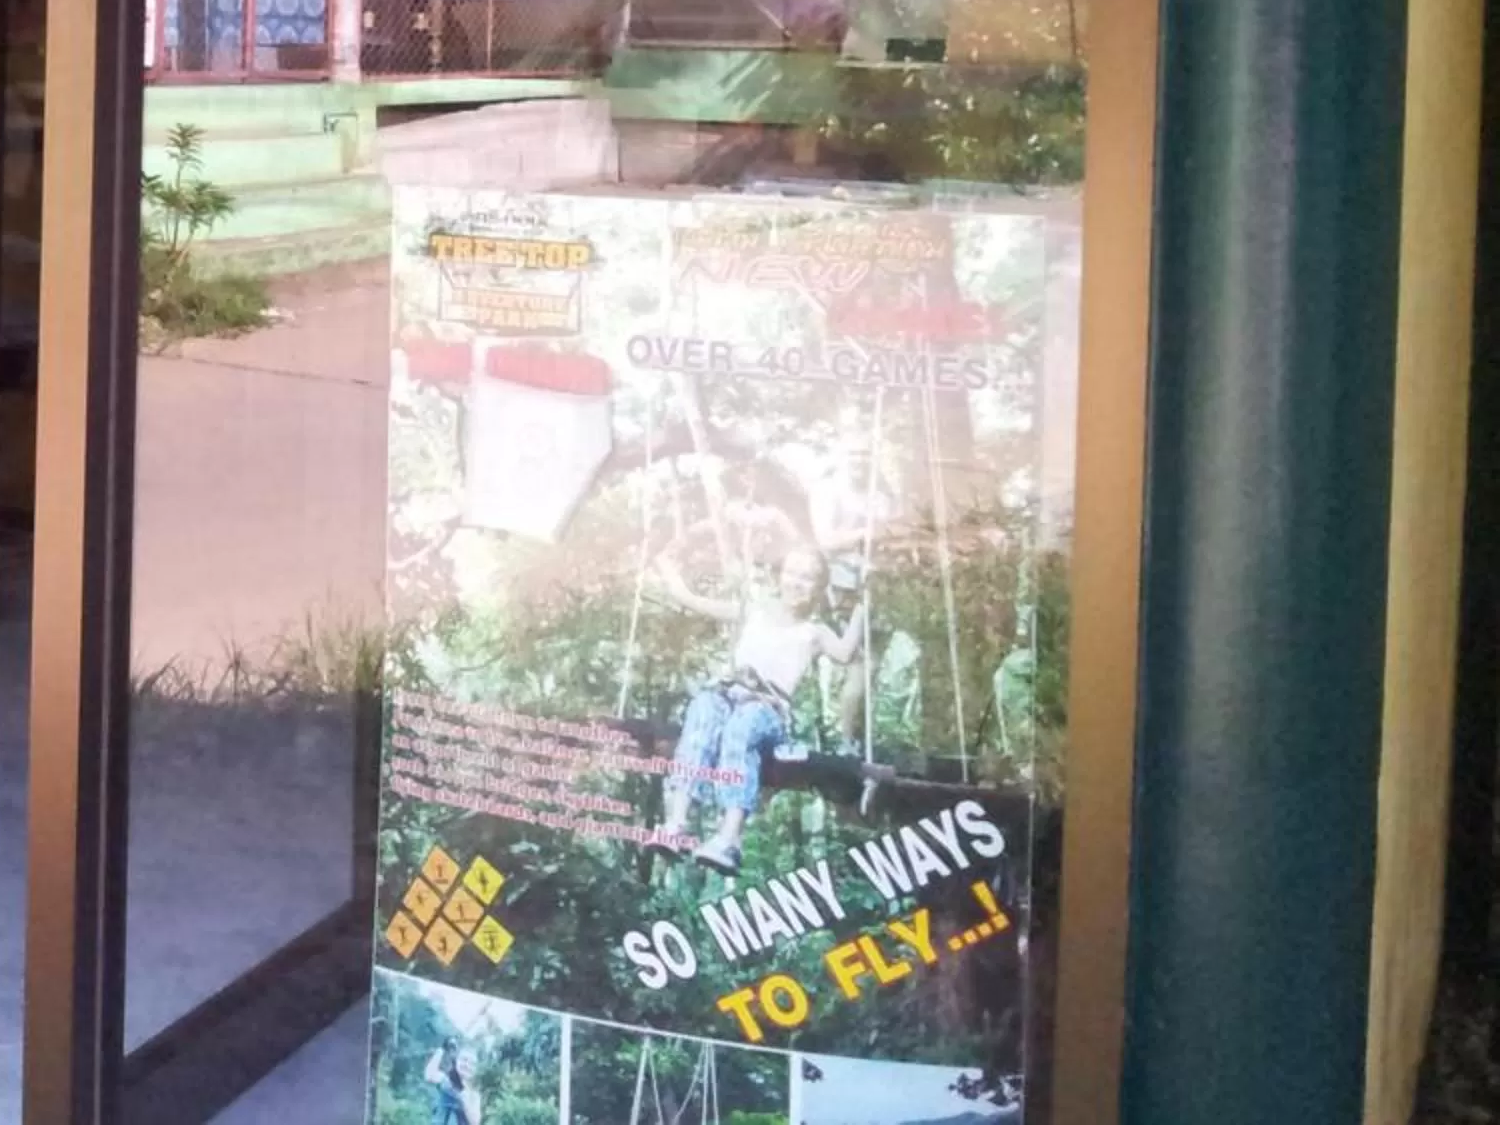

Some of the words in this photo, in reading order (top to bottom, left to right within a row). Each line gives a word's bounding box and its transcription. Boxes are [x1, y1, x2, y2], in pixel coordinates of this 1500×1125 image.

[626, 334, 735, 374] OVER
[756, 345, 806, 377] 40
[621, 919, 698, 990] SO
[699, 861, 847, 963] MANY
[848, 799, 1006, 901] WAYS
[715, 973, 810, 1044] TO
